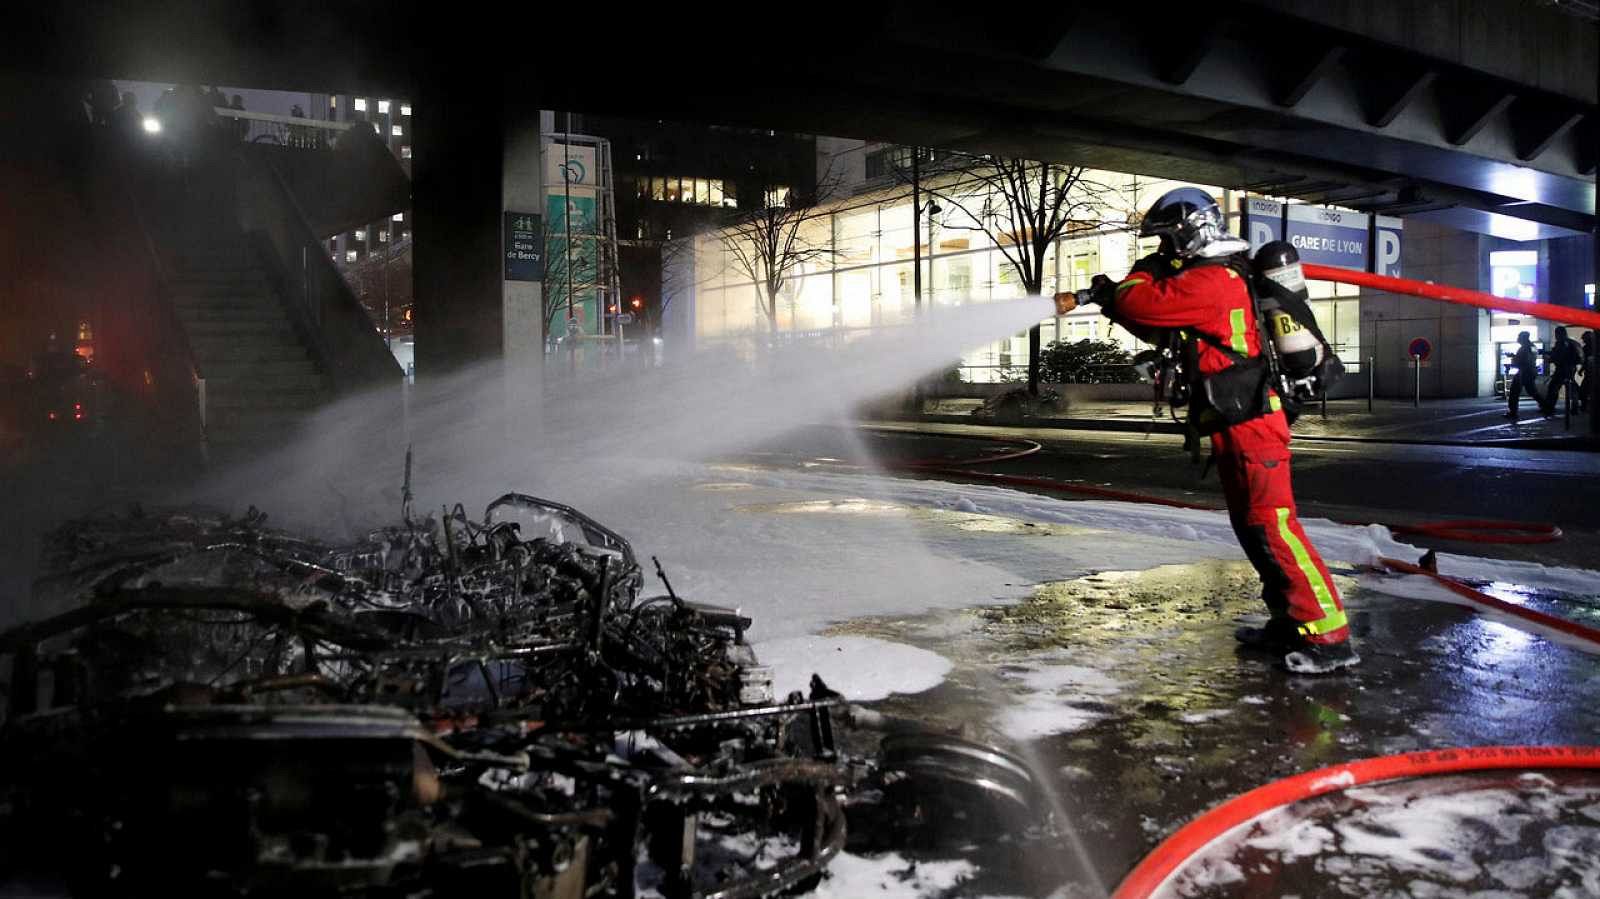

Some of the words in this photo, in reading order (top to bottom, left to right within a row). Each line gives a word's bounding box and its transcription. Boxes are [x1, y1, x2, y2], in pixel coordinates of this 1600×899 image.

[1291, 234, 1320, 250] GARE
[1321, 238, 1336, 252] DE
[1337, 240, 1363, 254] LYON
[1377, 229, 1401, 277] P
[507, 251, 517, 259] de
[518, 250, 541, 262] Bercy
